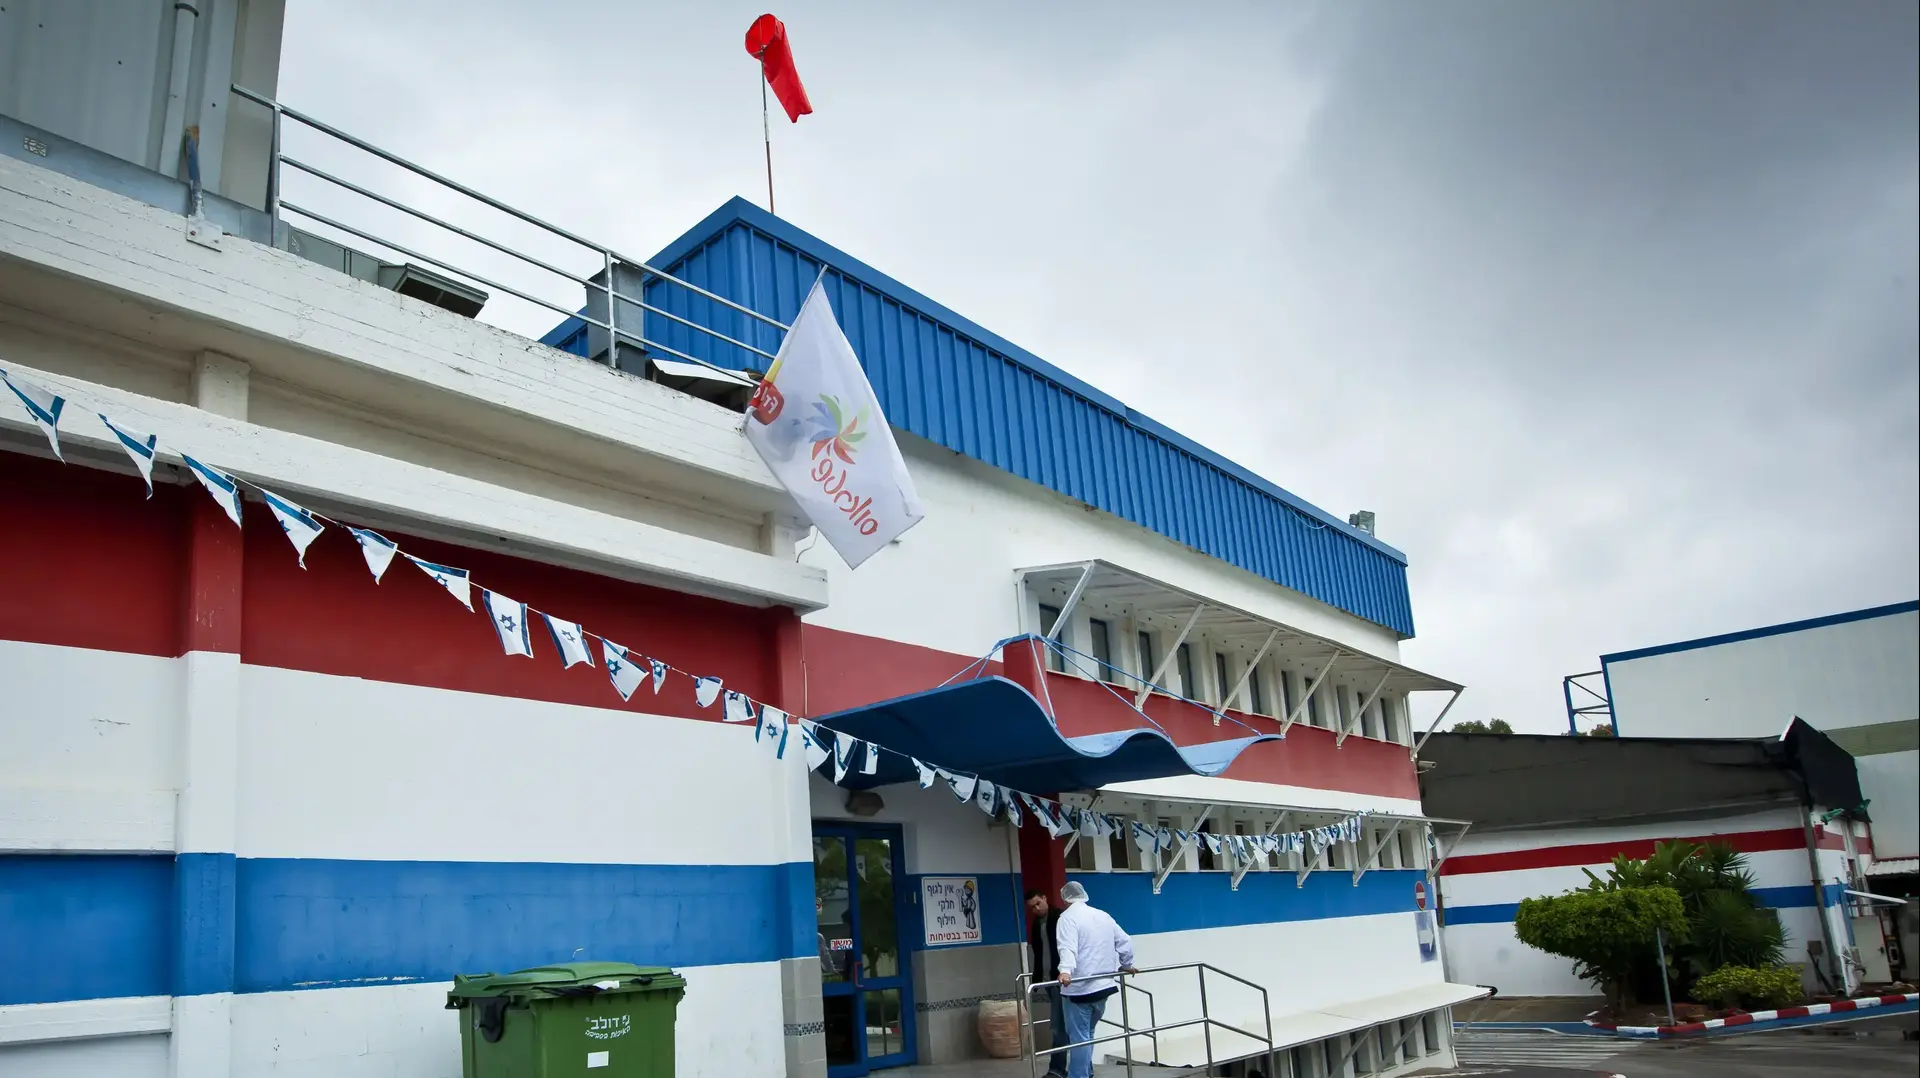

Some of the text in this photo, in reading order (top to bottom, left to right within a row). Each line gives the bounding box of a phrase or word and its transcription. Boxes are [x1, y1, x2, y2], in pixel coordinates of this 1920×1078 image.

[927, 882, 954, 896] אין לגוף
[938, 898, 955, 912] חלקי
[936, 914, 956, 928] חילוף
[930, 931, 979, 941] עבוד בבטיחות
[590, 1016, 620, 1030] דולב
